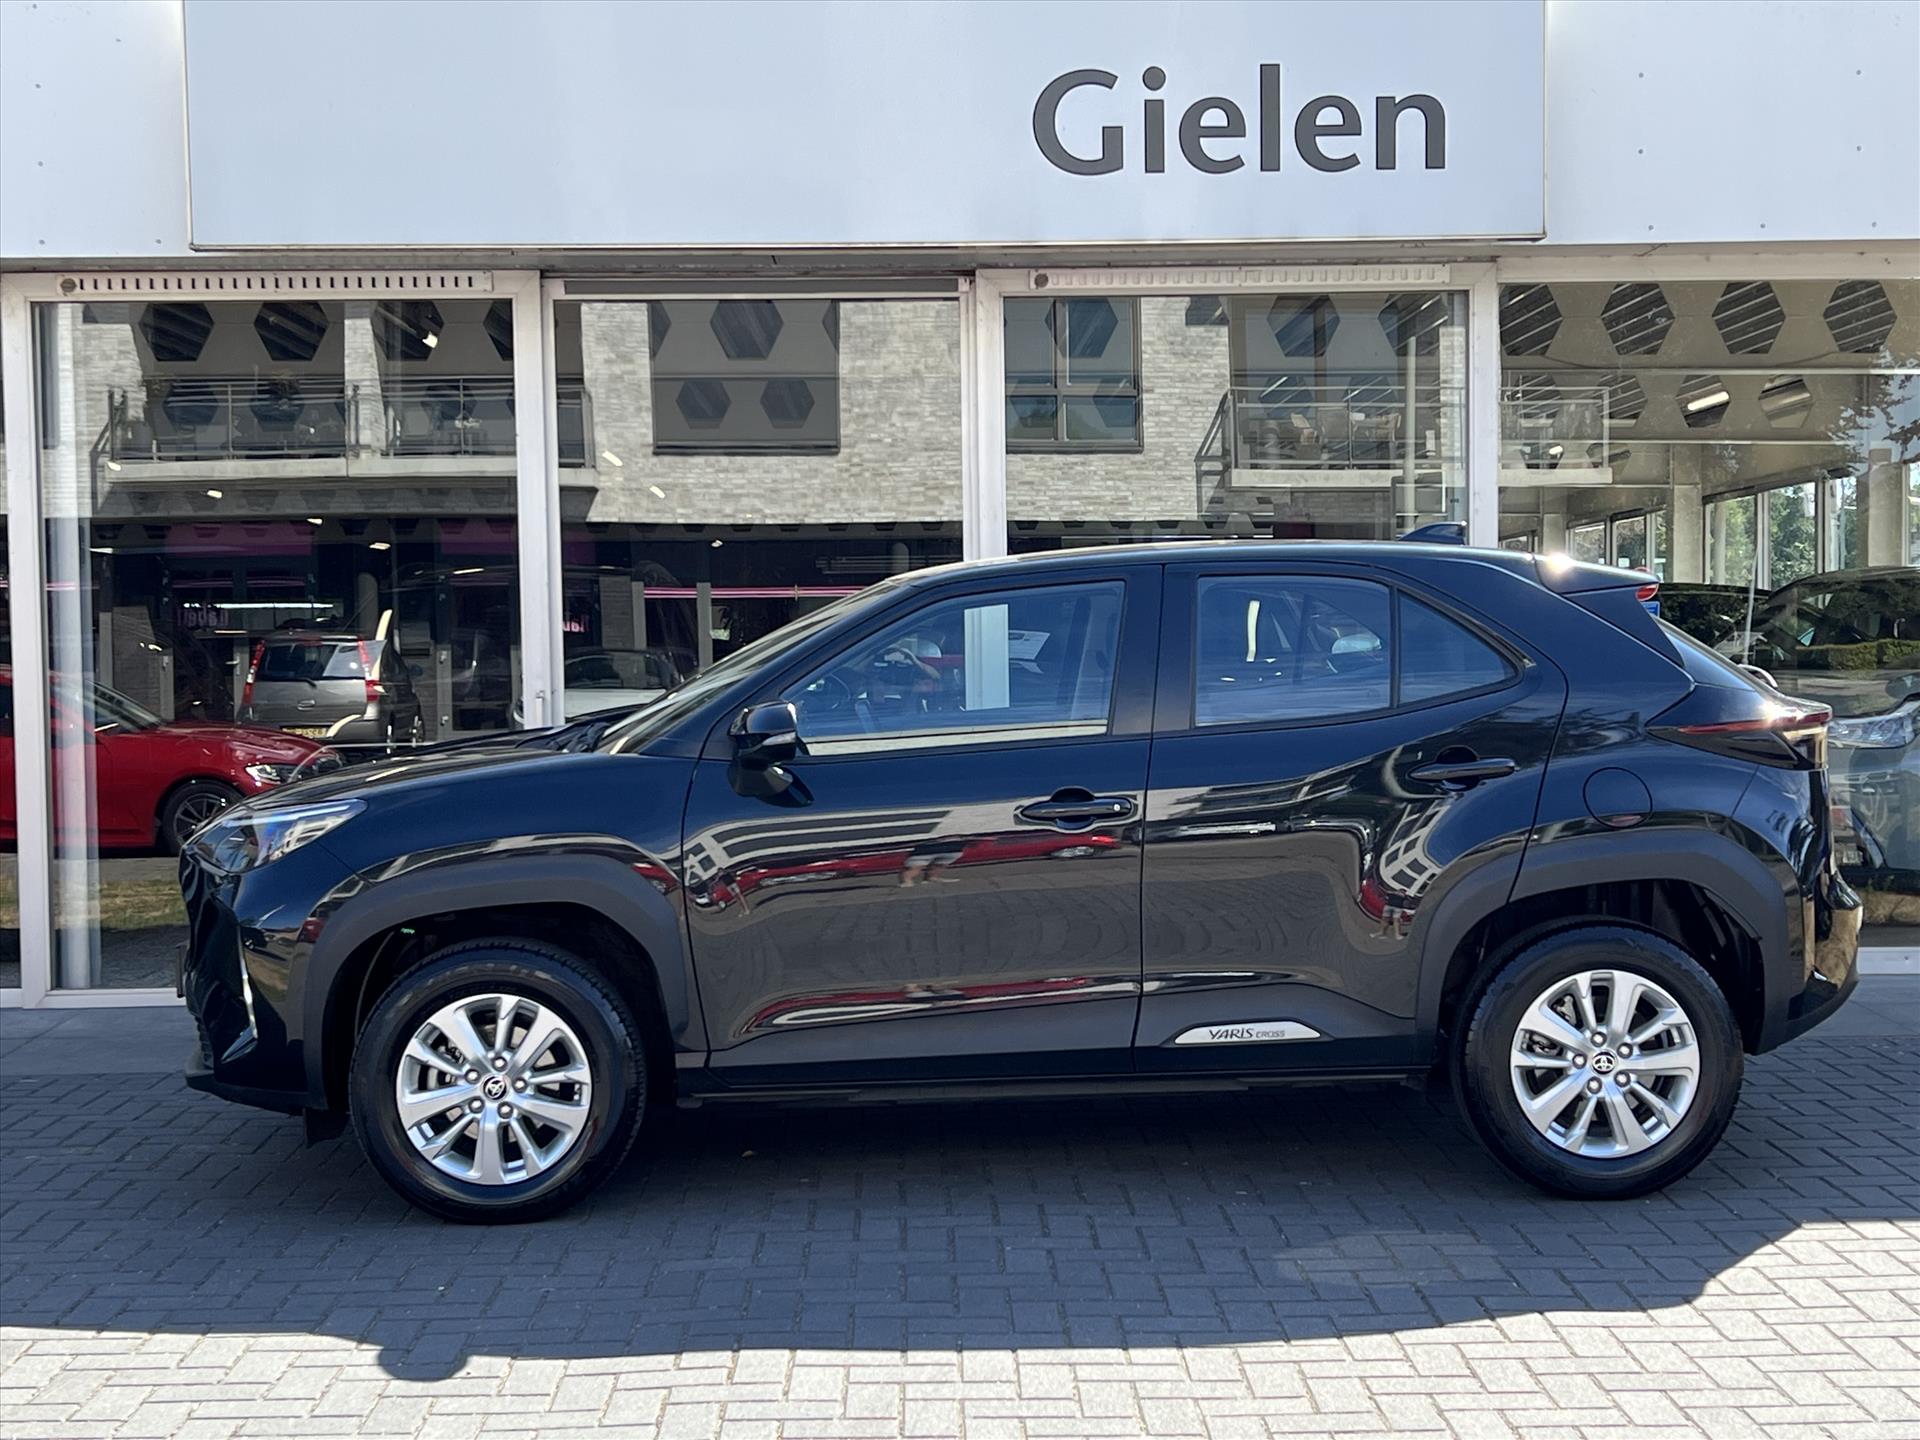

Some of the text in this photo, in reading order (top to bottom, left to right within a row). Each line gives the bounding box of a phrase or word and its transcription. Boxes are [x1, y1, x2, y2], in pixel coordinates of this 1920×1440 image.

[1032, 63, 1447, 176] Gielen
[1208, 1027, 1286, 1040] YARIS CROSS
